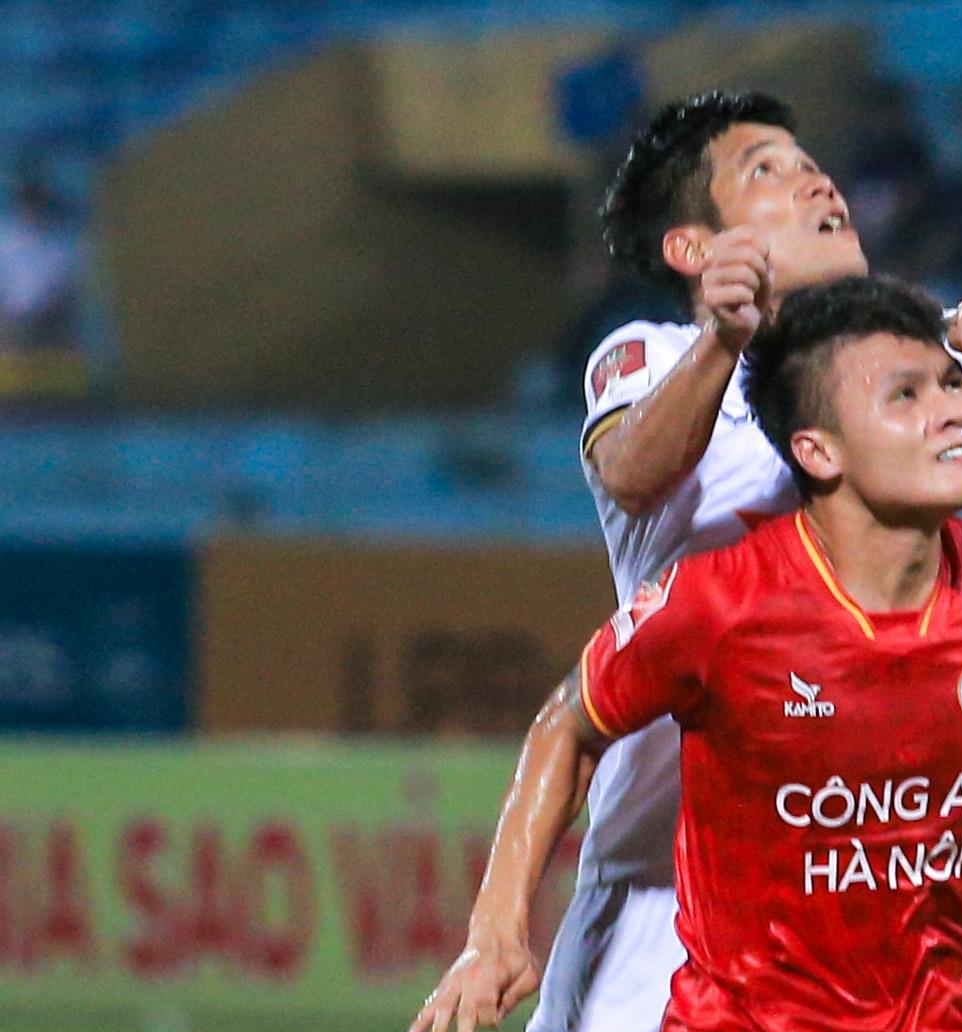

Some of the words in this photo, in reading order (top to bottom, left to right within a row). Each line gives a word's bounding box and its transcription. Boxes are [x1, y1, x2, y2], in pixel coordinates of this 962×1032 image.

[783, 700, 836, 718] KAMITO
[775, 775, 930, 828] CÔNG
[803, 838, 878, 896] HÀ
